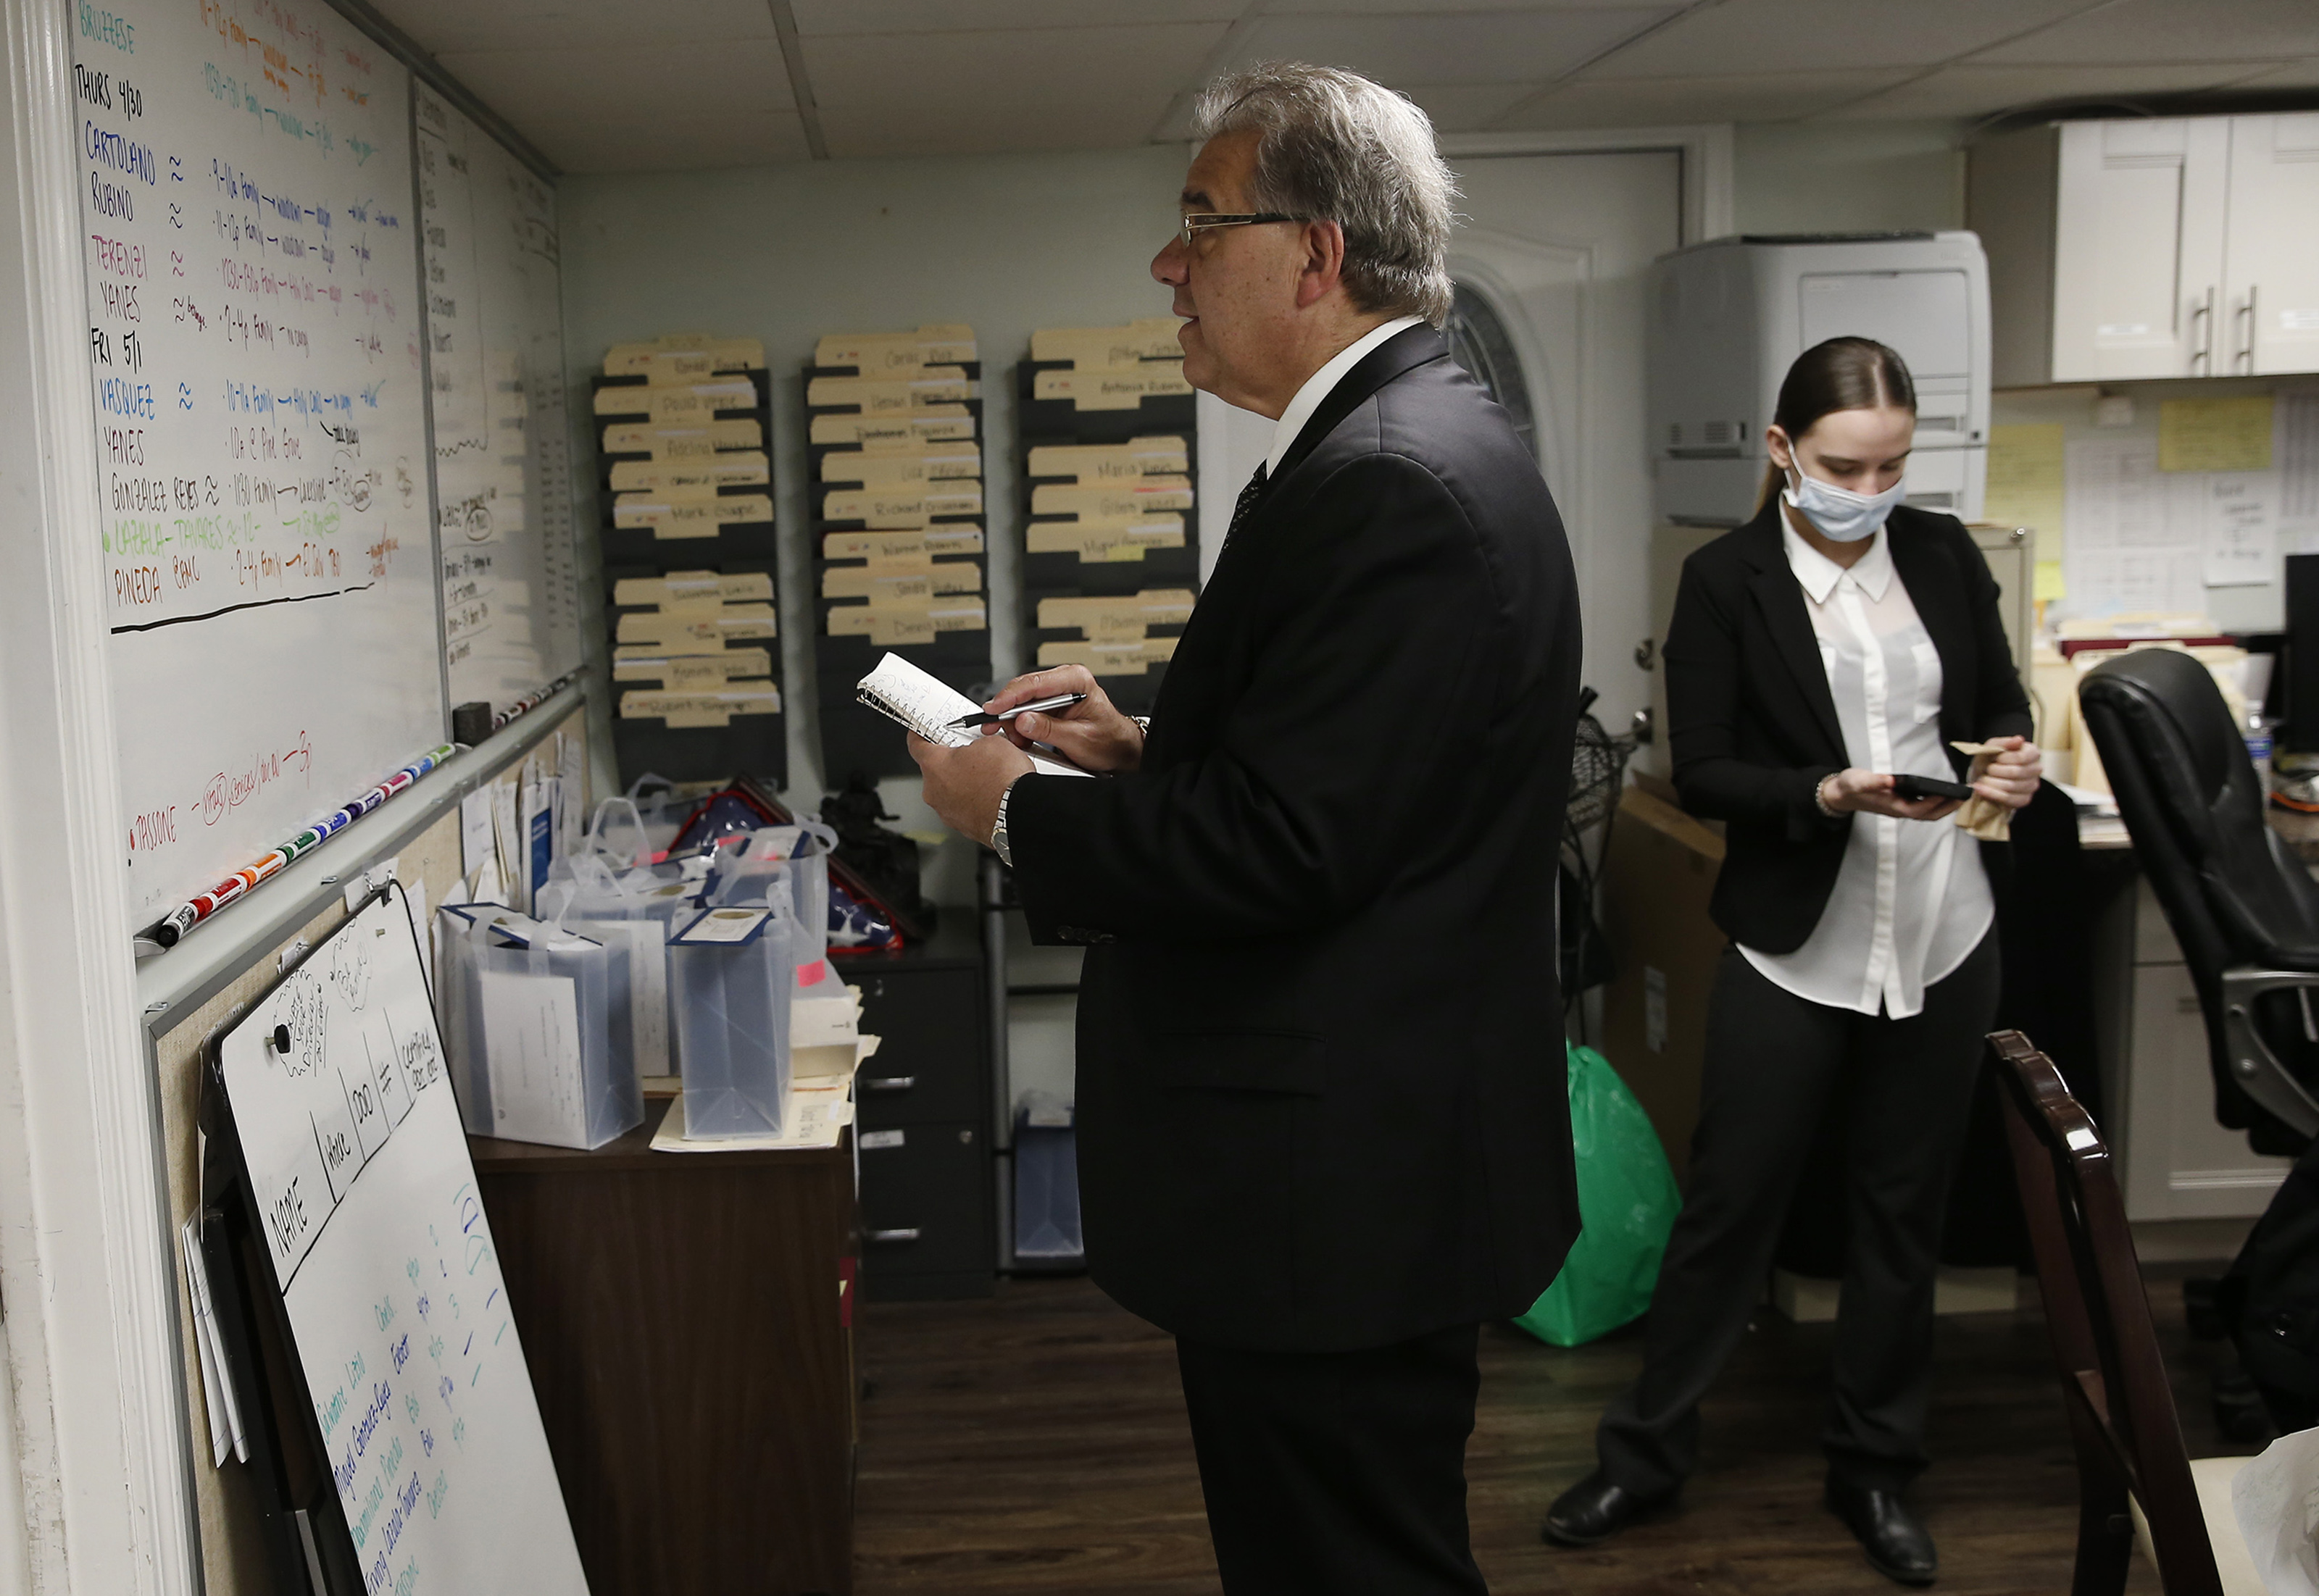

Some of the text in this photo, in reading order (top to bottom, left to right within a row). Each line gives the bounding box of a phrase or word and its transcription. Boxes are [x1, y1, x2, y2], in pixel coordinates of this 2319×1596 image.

[79, 0, 135, 54] BRUZZESE
[75, 64, 143, 121] THURS 4/30
[86, 120, 155, 185] CARTOLANO
[91, 171, 133, 222] RUBINO
[91, 234, 148, 281] TERENZI
[100, 280, 141, 322] YANES
[91, 327, 142, 374] FRI 5/1
[99, 377, 154, 420] VASQUEZ
[104, 425, 144, 466] YANES
[112, 472, 167, 513] GONZALEZ
[173, 476, 199, 512] REYES
[115, 566, 163, 606] PINEDA
[270, 1175, 307, 1258] NAME
